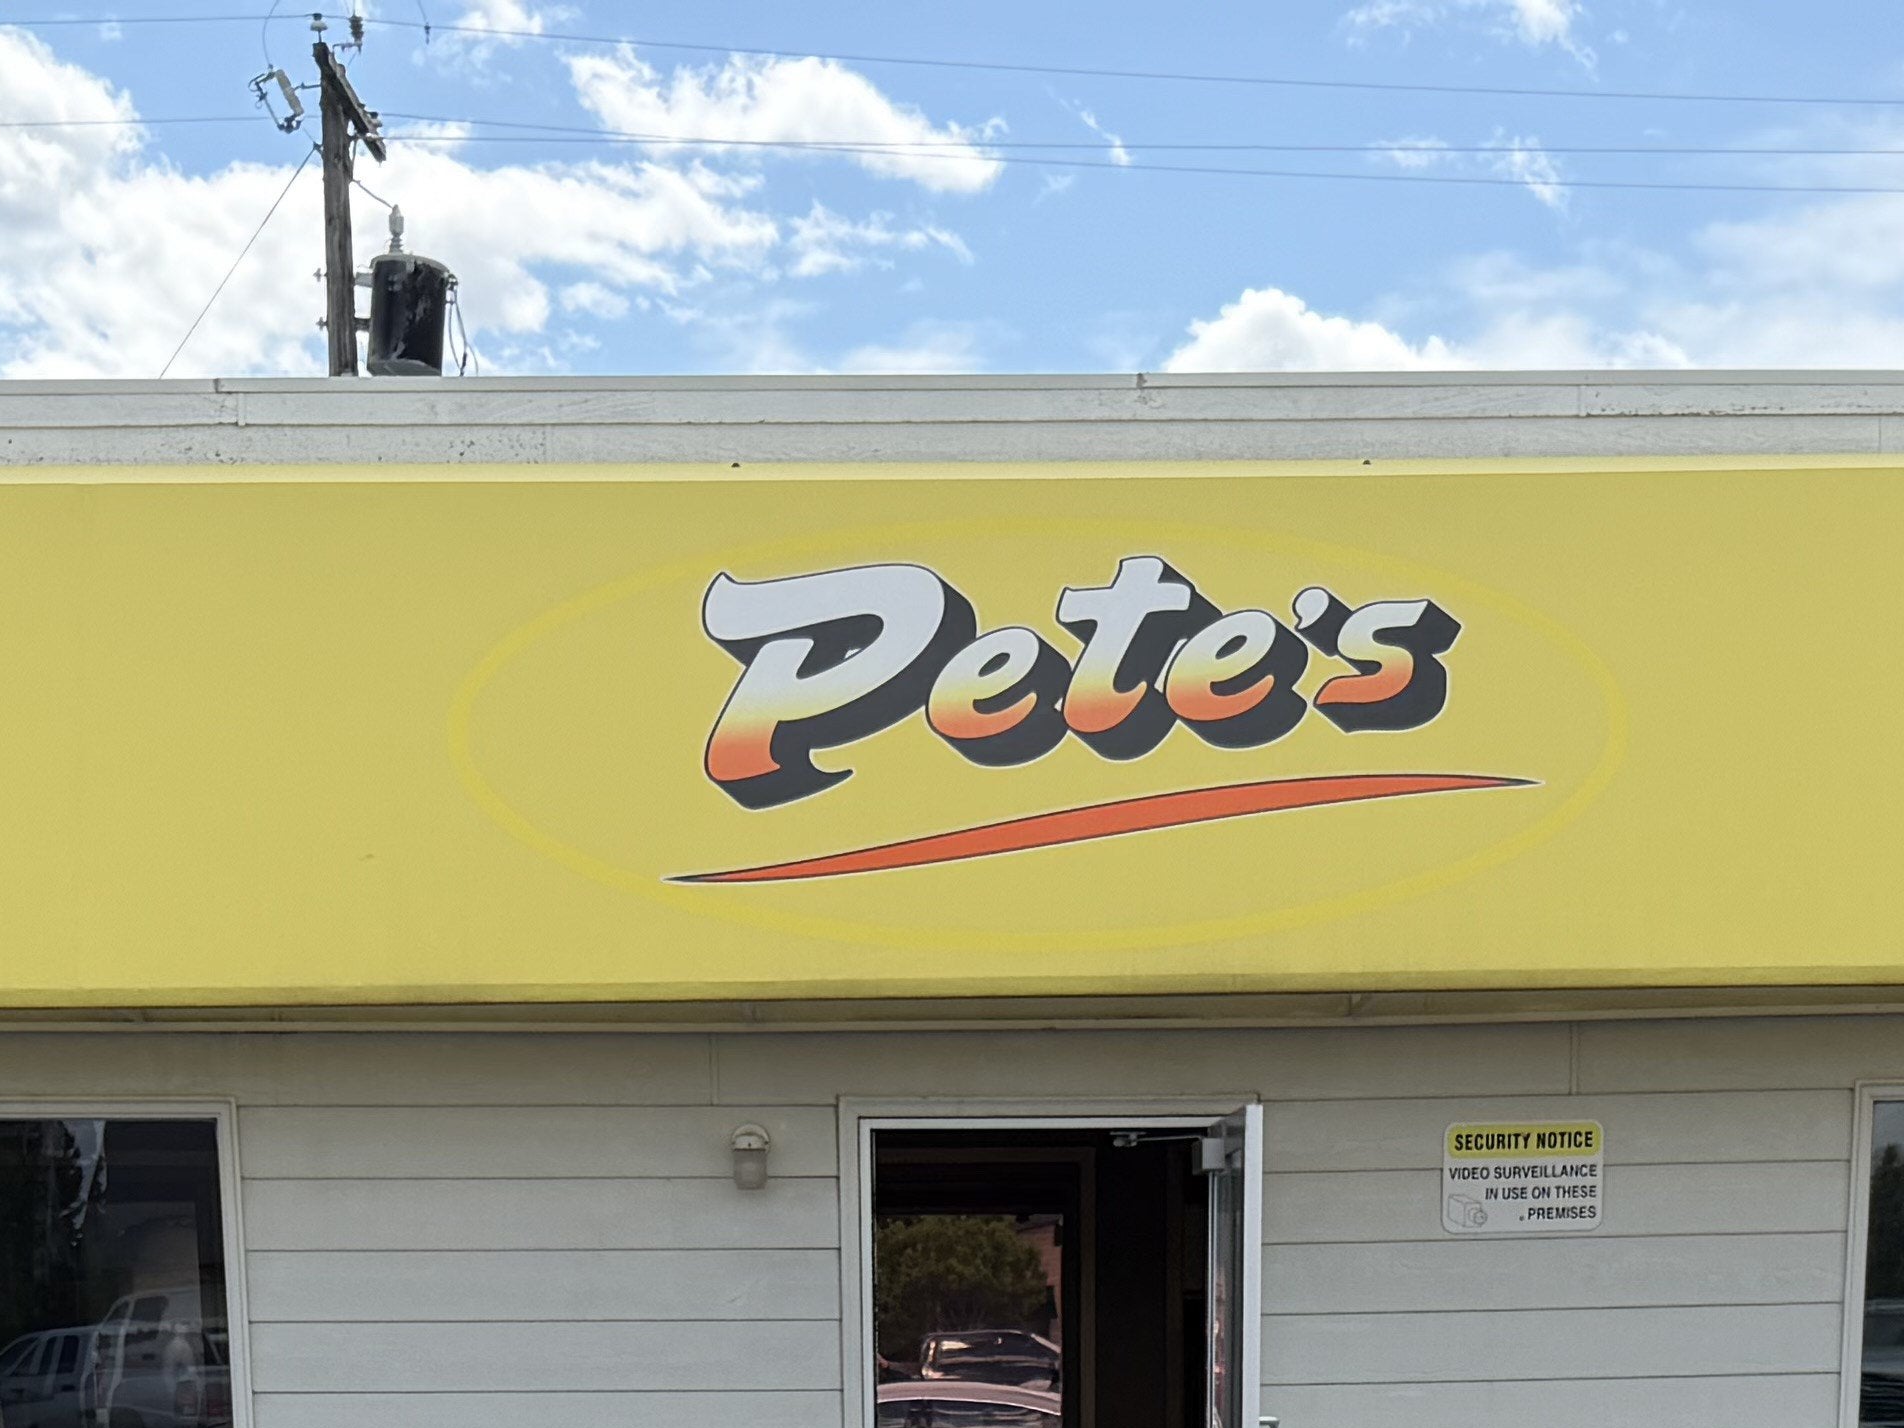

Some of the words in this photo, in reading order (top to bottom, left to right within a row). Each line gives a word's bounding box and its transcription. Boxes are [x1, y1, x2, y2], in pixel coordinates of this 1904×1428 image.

[702, 556, 1461, 810] Pete's
[1454, 1133, 1531, 1151] SECURITY
[1536, 1131, 1593, 1148] NOTICE
[1449, 1167, 1490, 1180] VIDEO
[1494, 1164, 1597, 1179] SURVEILLANCE
[1485, 1188, 1498, 1200] IN
[1502, 1187, 1528, 1200] USE
[1532, 1187, 1551, 1199] ON
[1554, 1185, 1597, 1199] THESE
[1528, 1206, 1597, 1221] PREMISES
